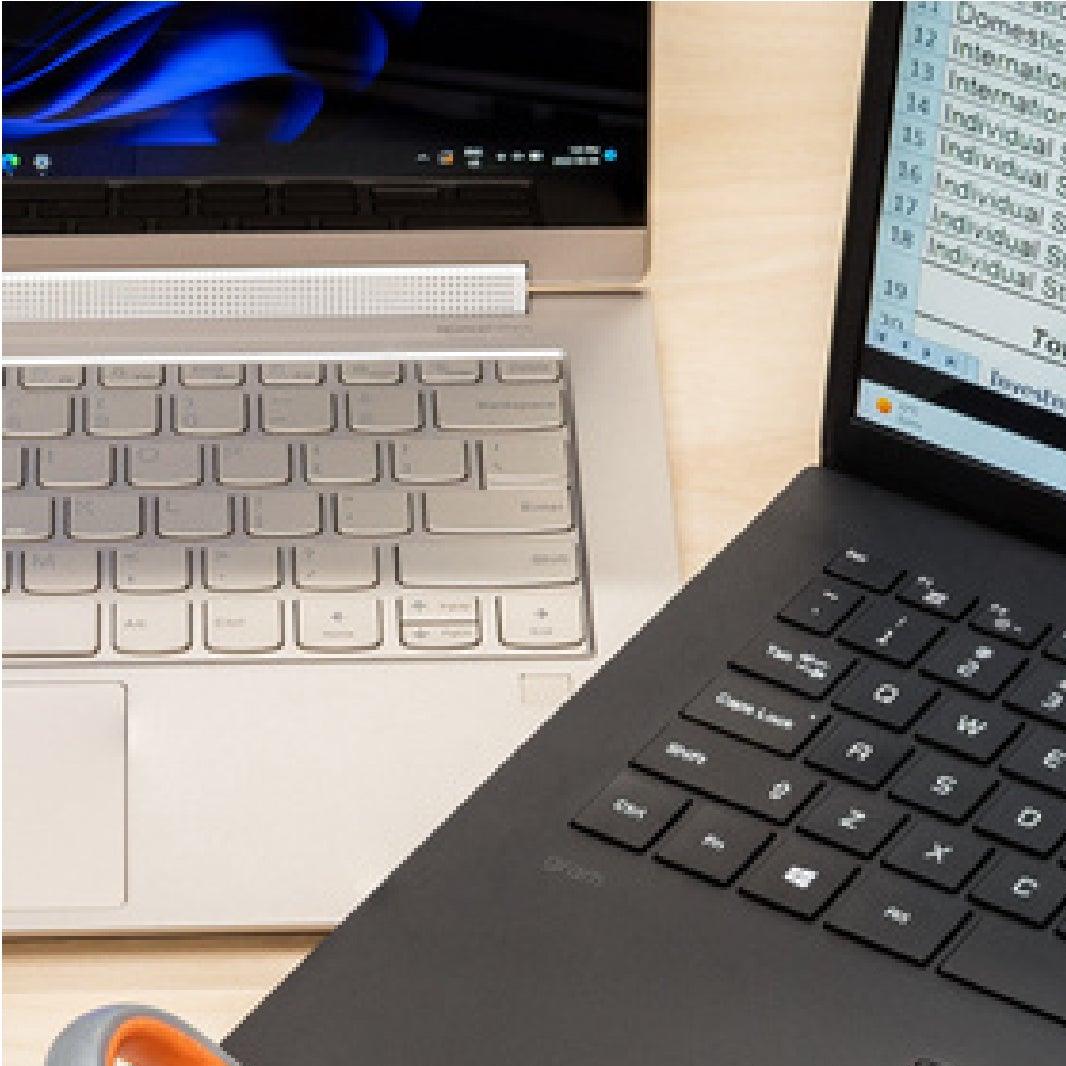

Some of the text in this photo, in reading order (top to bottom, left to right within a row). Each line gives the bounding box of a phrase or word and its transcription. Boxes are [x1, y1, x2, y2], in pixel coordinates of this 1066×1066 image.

[943, 103, 1053, 157] Individual
[939, 134, 1049, 190] Individual
[935, 169, 1045, 226] Individual
[931, 204, 1041, 259] Individual
[928, 237, 1036, 291] Individual
